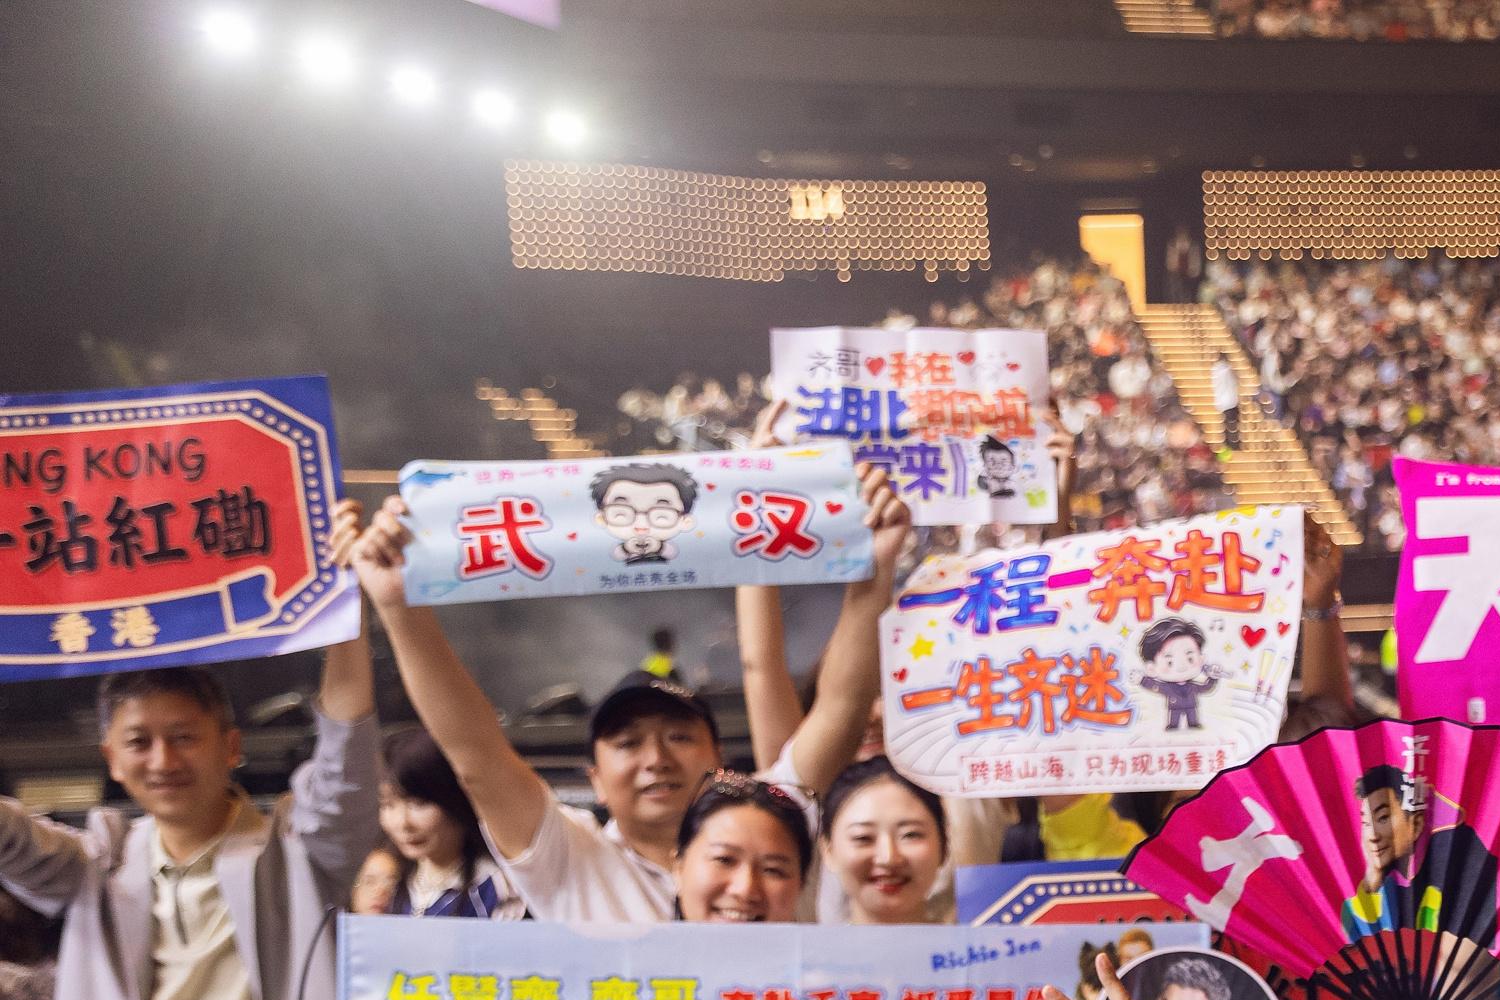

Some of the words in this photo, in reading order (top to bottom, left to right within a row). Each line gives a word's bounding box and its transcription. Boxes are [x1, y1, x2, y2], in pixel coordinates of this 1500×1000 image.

[83, 438, 205, 482] KONG
[0, 486, 271, 572] 站紅磡
[459, 497, 551, 579] 武
[731, 490, 822, 558] 汉
[898, 528, 1267, 634] 一程一奔赴
[50, 606, 159, 653] 香港
[901, 645, 1134, 738] 一生齐迷
